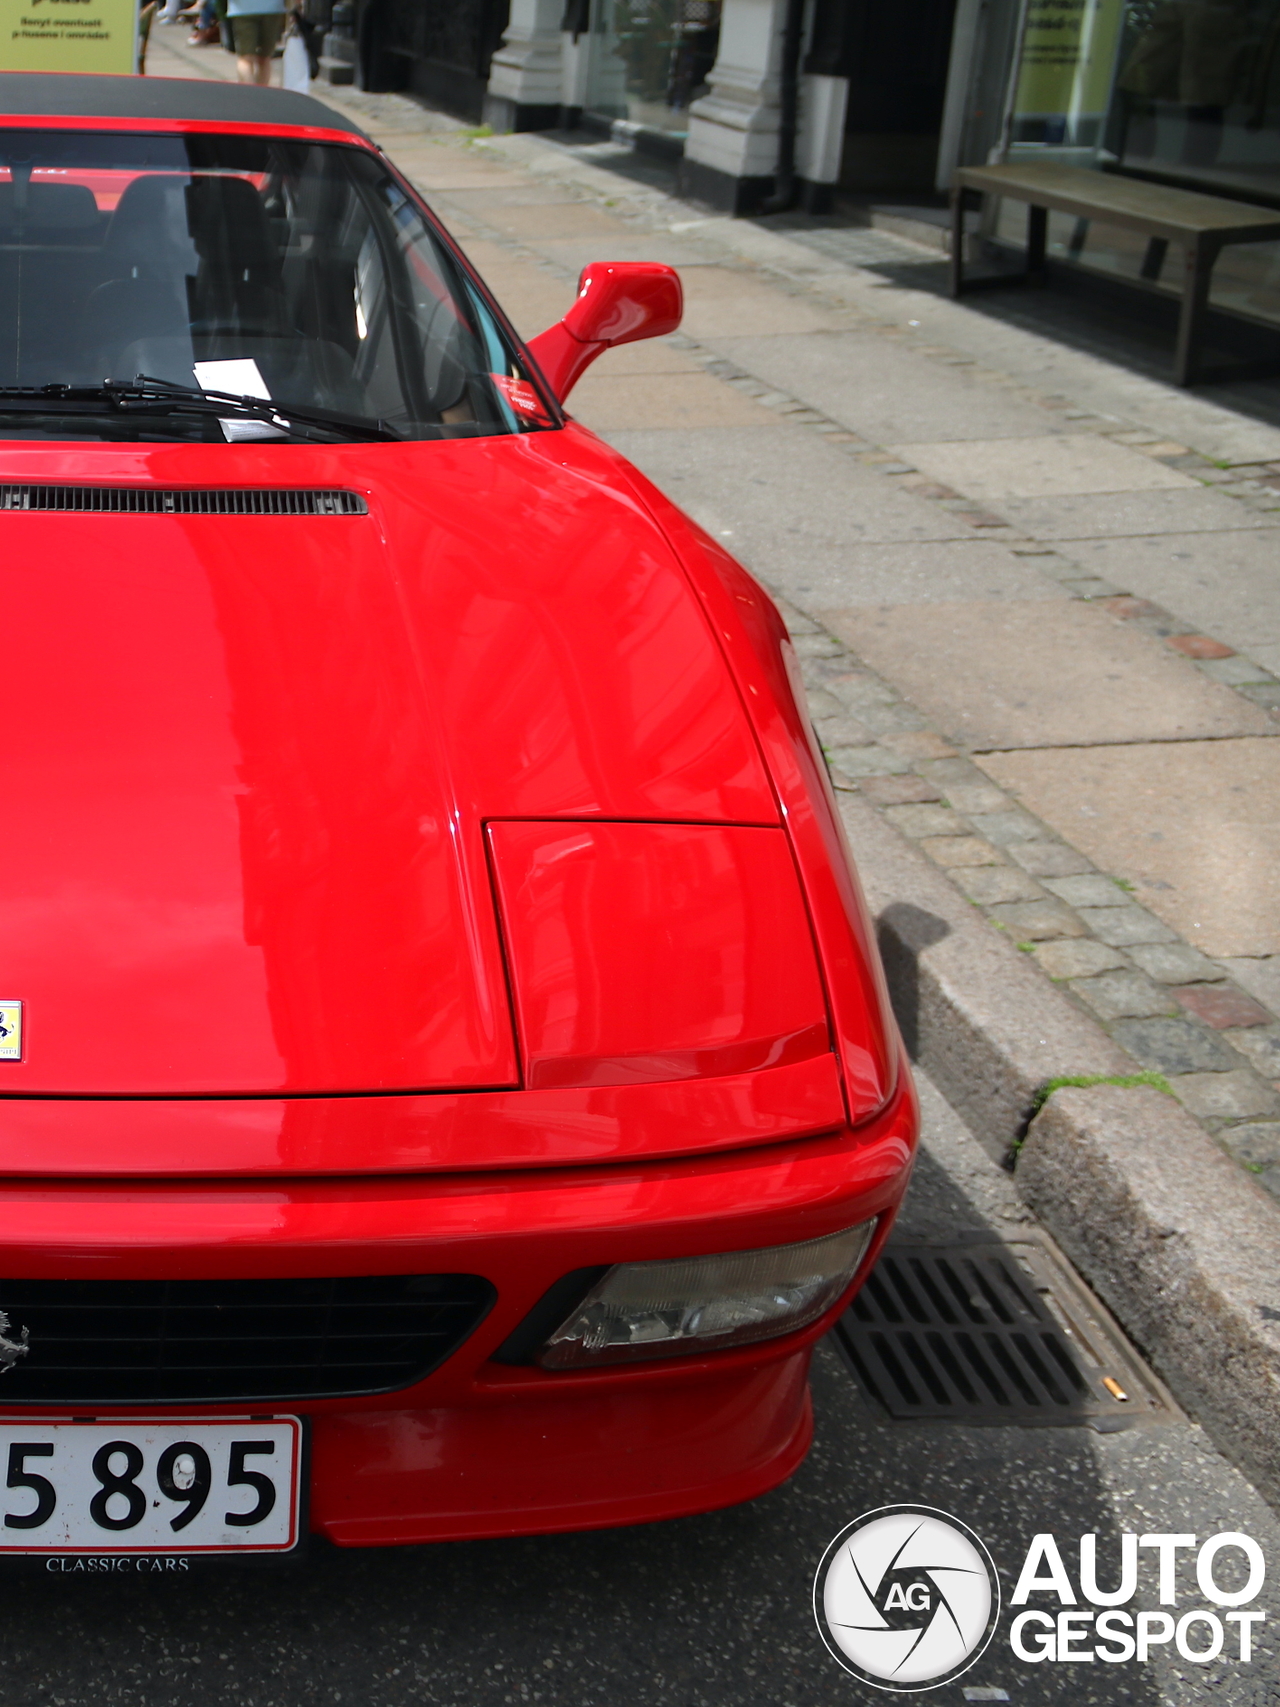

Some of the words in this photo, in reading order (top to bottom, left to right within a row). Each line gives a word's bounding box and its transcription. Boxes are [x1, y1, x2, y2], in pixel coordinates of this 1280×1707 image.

[21, 16, 51, 27] Benyt
[90, 1440, 276, 1532] 895
[46, 1557, 130, 1572] CLASSIC
[136, 1557, 189, 1572] CARS
